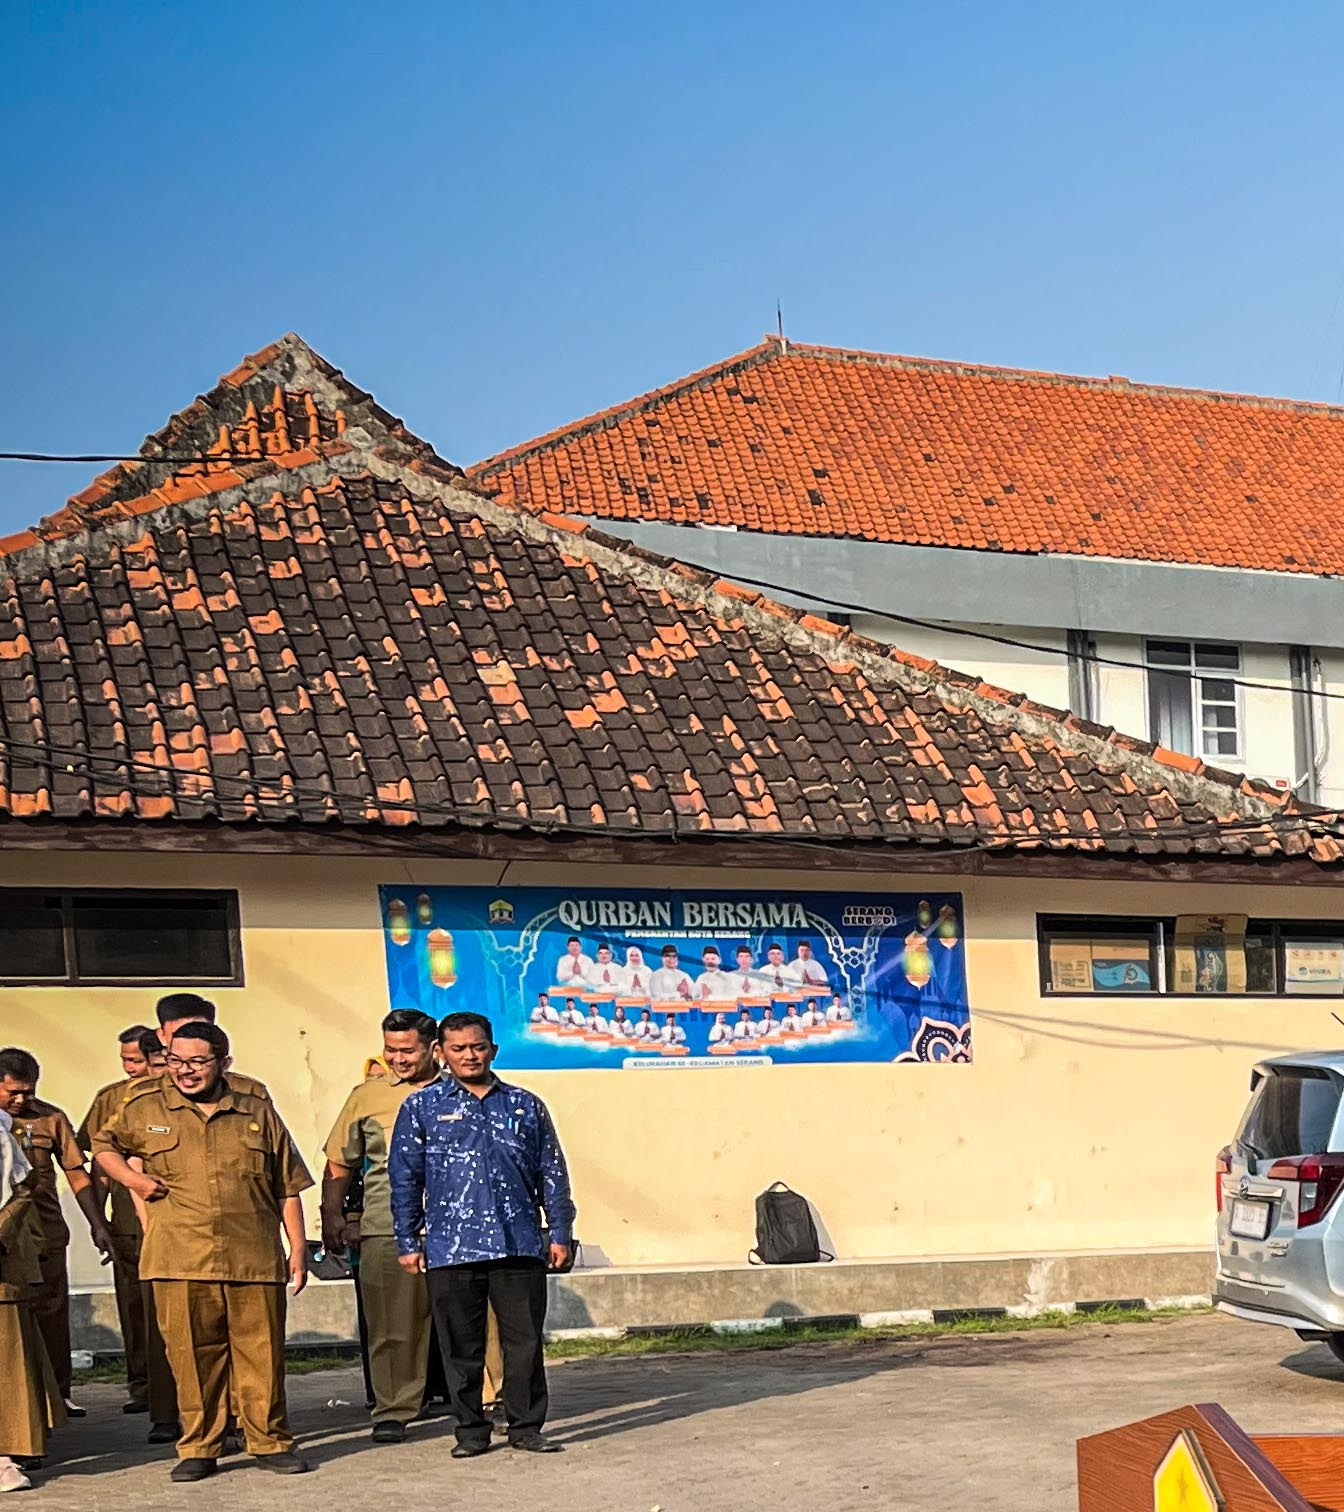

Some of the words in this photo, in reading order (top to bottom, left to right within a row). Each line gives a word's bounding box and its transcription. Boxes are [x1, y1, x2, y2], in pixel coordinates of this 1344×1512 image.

[558, 900, 672, 931] QURBAN
[683, 902, 811, 929] BERSAMA
[846, 907, 893, 916] SERANG
